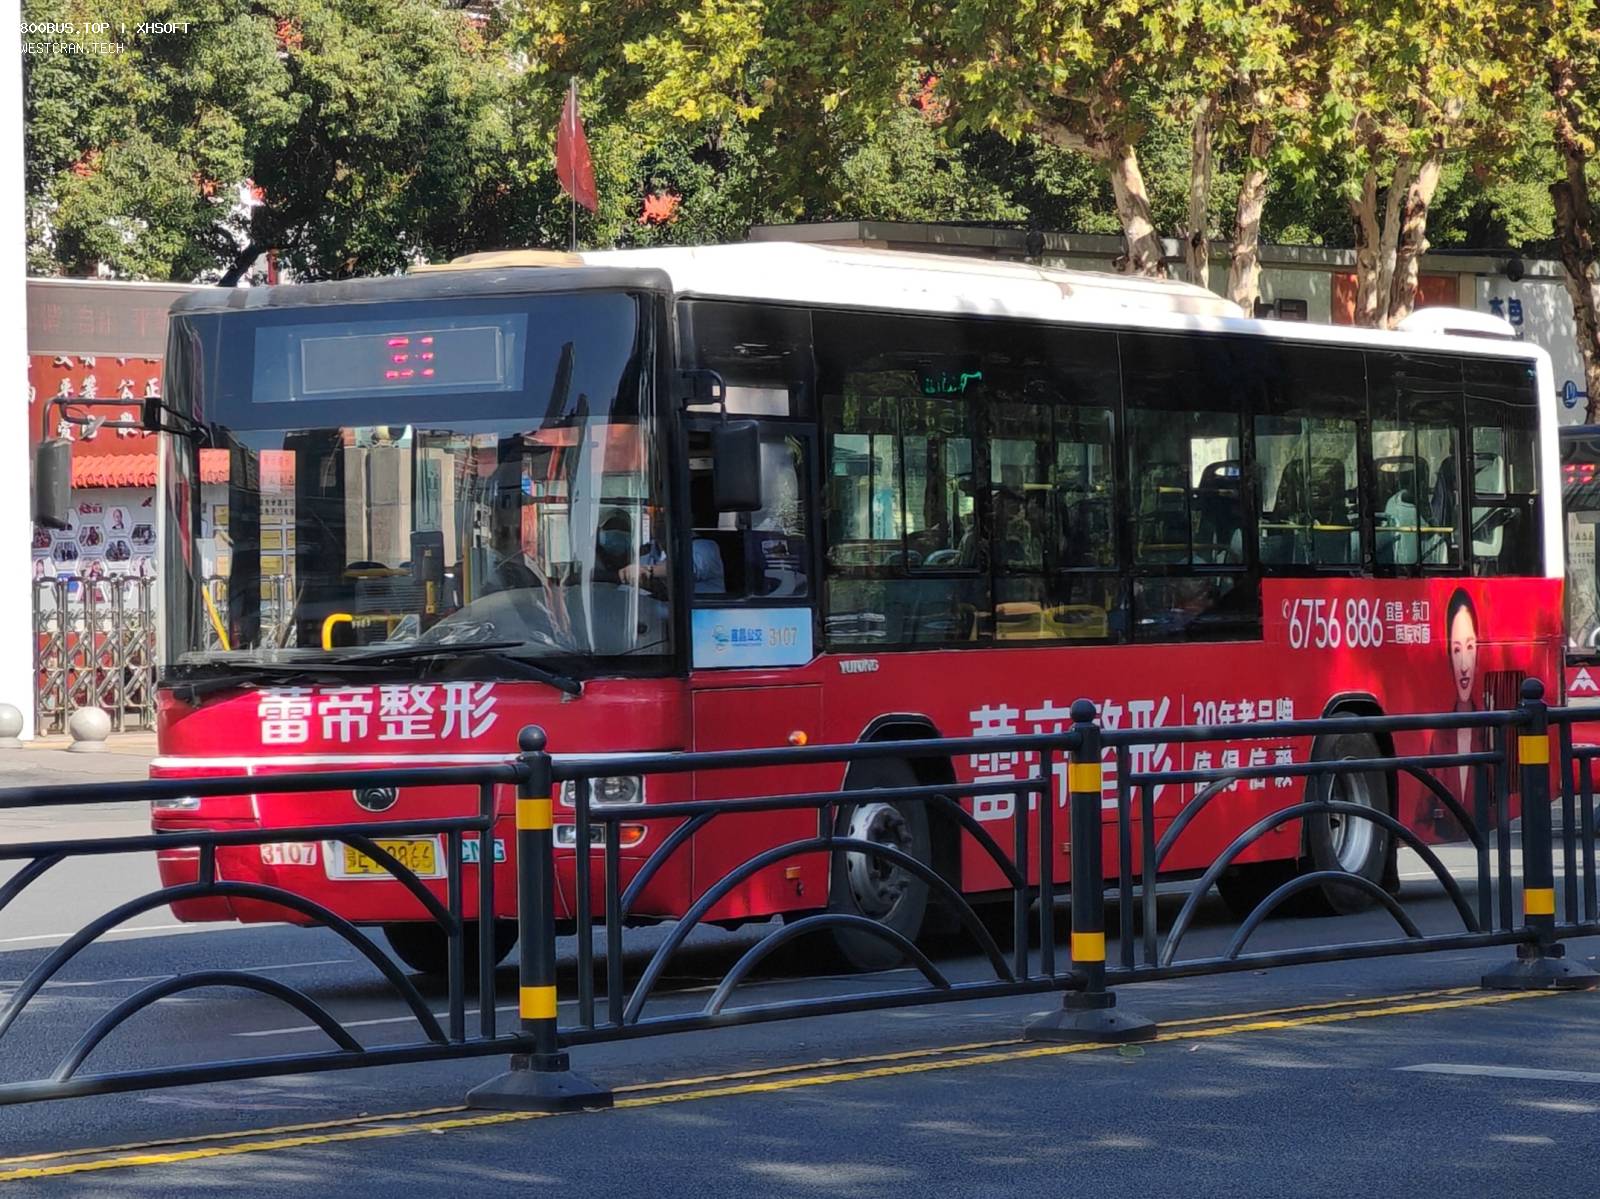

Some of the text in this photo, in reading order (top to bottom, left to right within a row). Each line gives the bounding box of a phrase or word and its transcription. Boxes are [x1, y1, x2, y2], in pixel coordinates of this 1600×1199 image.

[1289, 598, 1383, 649] 6756 886
[768, 627, 798, 646] 3107
[839, 659, 879, 674] YUTONG
[262, 844, 316, 864] 3107
